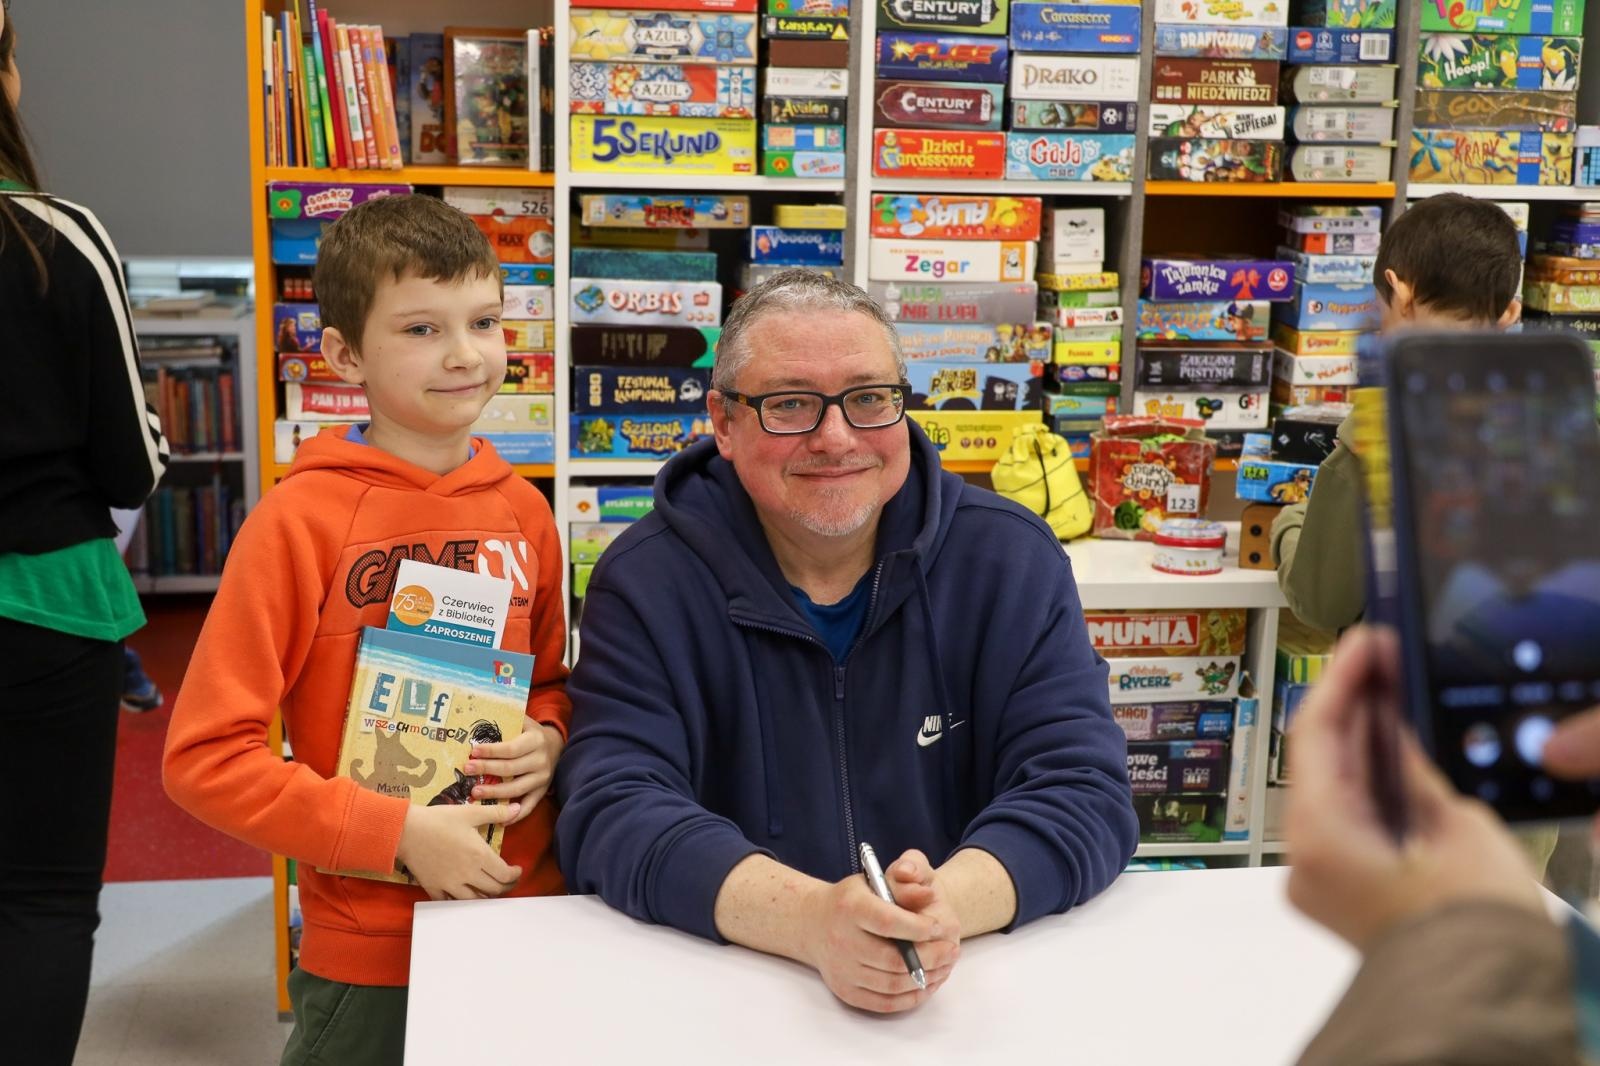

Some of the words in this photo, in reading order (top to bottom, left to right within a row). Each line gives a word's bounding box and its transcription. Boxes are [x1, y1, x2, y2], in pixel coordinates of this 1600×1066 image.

[642, 28, 682, 43] AZUL
[1443, 51, 1490, 81] Hooop!
[1022, 64, 1098, 90] DRAKO
[1201, 70, 1235, 83] PARK
[642, 82, 682, 97] AZUL
[1187, 83, 1272, 101] NIEDŹWIEDZI
[901, 91, 974, 112] CENTURY
[1234, 114, 1277, 135] SZPIEGA!
[592, 119, 621, 162] 5
[920, 138, 965, 153] Dzieci
[521, 201, 548, 214] 526
[925, 198, 989, 227] ALIAS
[498, 233, 524, 246] MAX
[905, 255, 970, 278] Zegar
[608, 290, 683, 314] ORBIS
[902, 304, 928, 320] NIE
[938, 304, 978, 320] LUBI
[1180, 366, 1235, 379] PUSTYNIA
[617, 376, 672, 389] FESTIWAL
[621, 420, 682, 436] SZALONA
[1172, 498, 1196, 509] 123
[345, 540, 479, 608] GAME
[478, 539, 529, 590] ON
[395, 592, 417, 610] 75
[441, 595, 494, 614] Czerwiec
[446, 608, 495, 627] Biblioteką
[424, 623, 492, 645] ZAPROSZENIE
[1088, 620, 1194, 645] MUMIA
[1119, 674, 1171, 690] RYCERZ
[1113, 707, 1148, 720] CIĄGU
[1127, 754, 1158, 766] owe
[376, 782, 410, 794] Marcin
